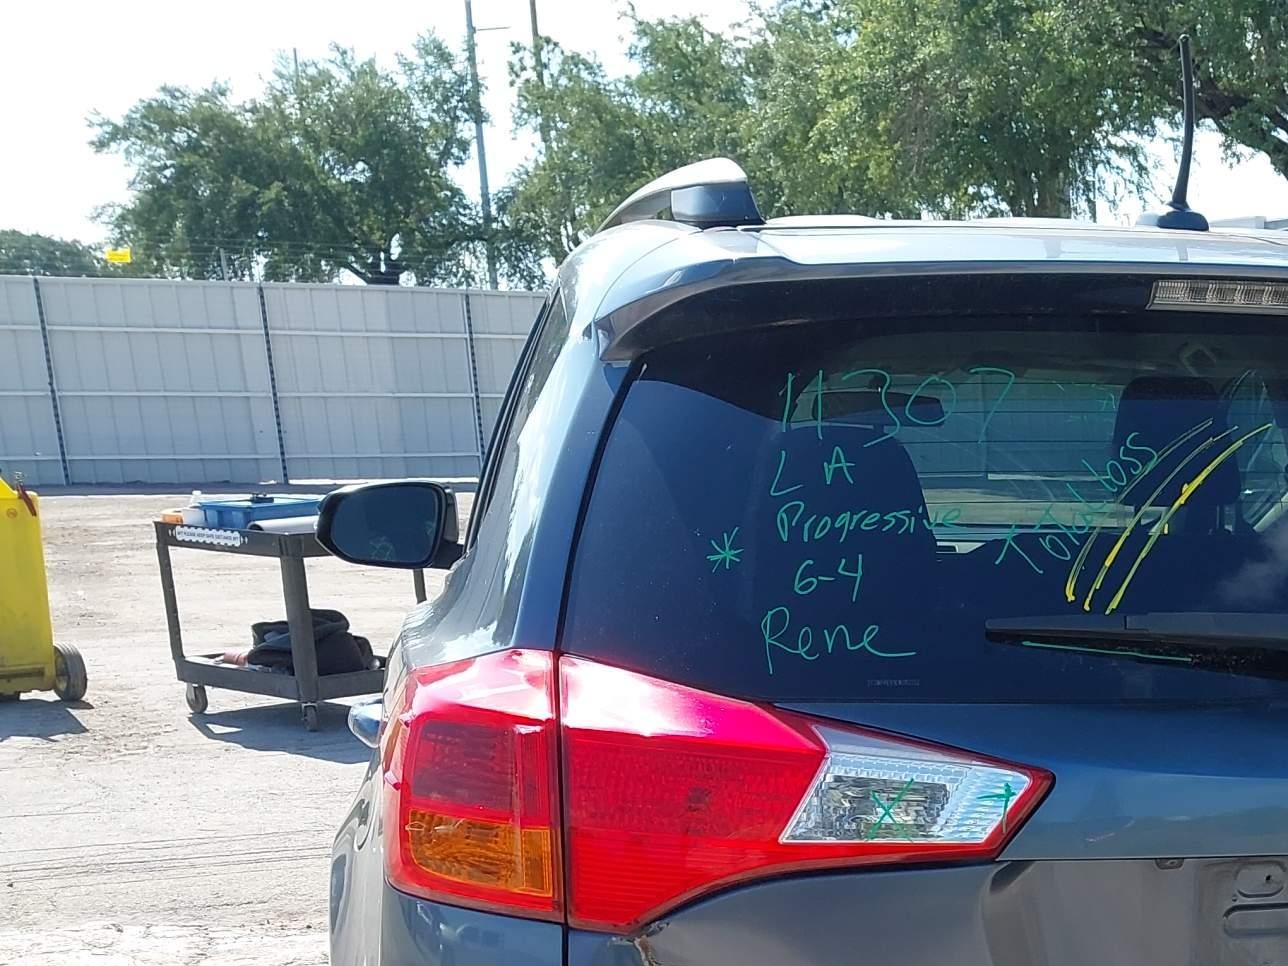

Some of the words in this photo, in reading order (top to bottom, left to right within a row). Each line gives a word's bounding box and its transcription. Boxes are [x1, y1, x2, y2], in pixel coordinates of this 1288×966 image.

[776, 501, 966, 543] Progressive
[793, 554, 863, 602] 6-4
[761, 606, 917, 675] Rene
